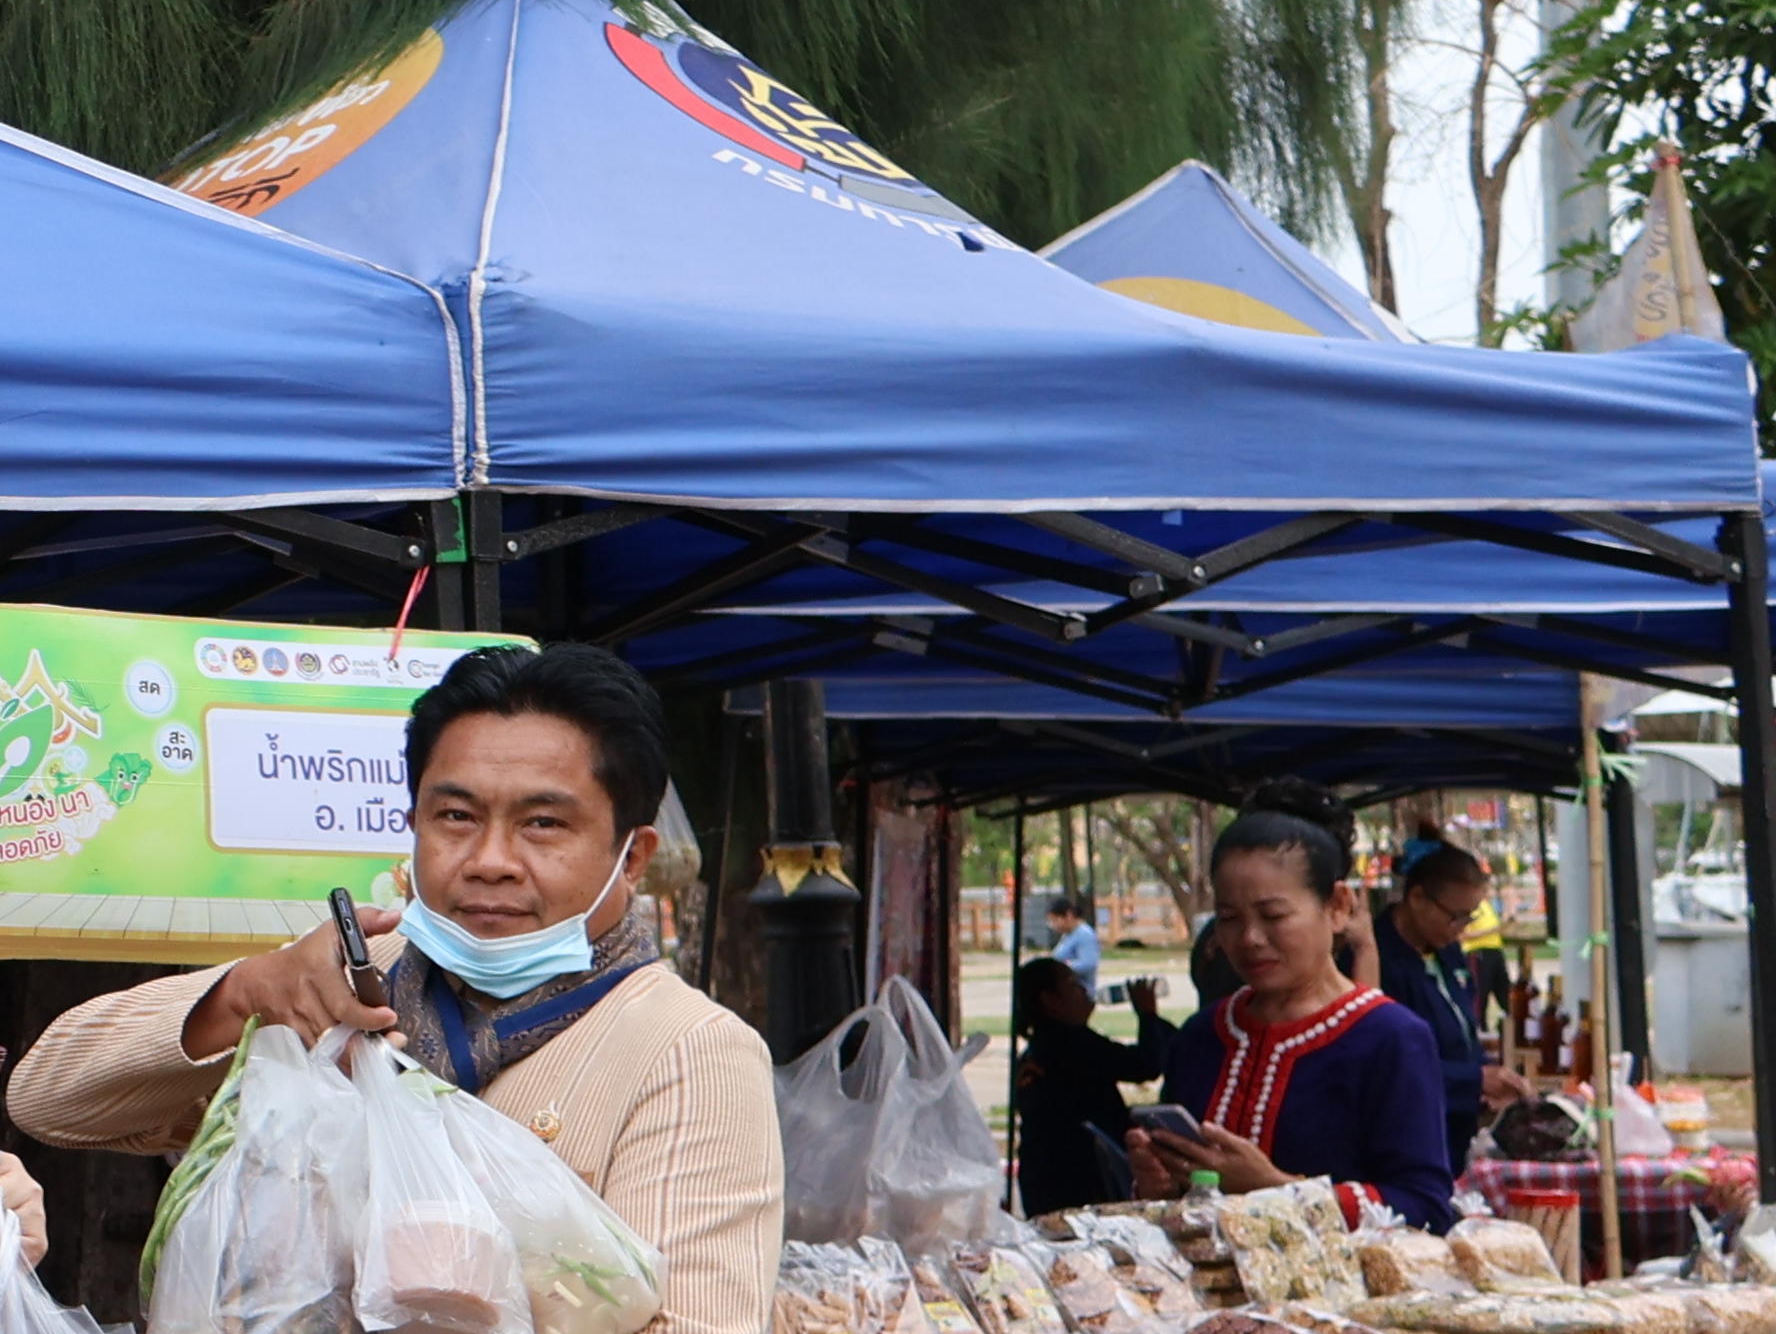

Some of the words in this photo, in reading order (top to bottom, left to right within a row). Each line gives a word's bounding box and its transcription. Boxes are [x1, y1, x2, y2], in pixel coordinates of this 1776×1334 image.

[138, 680, 161, 695] สด
[168, 730, 187, 745] สะ
[60, 789, 91, 814] นา
[356, 796, 408, 834] เมือ
